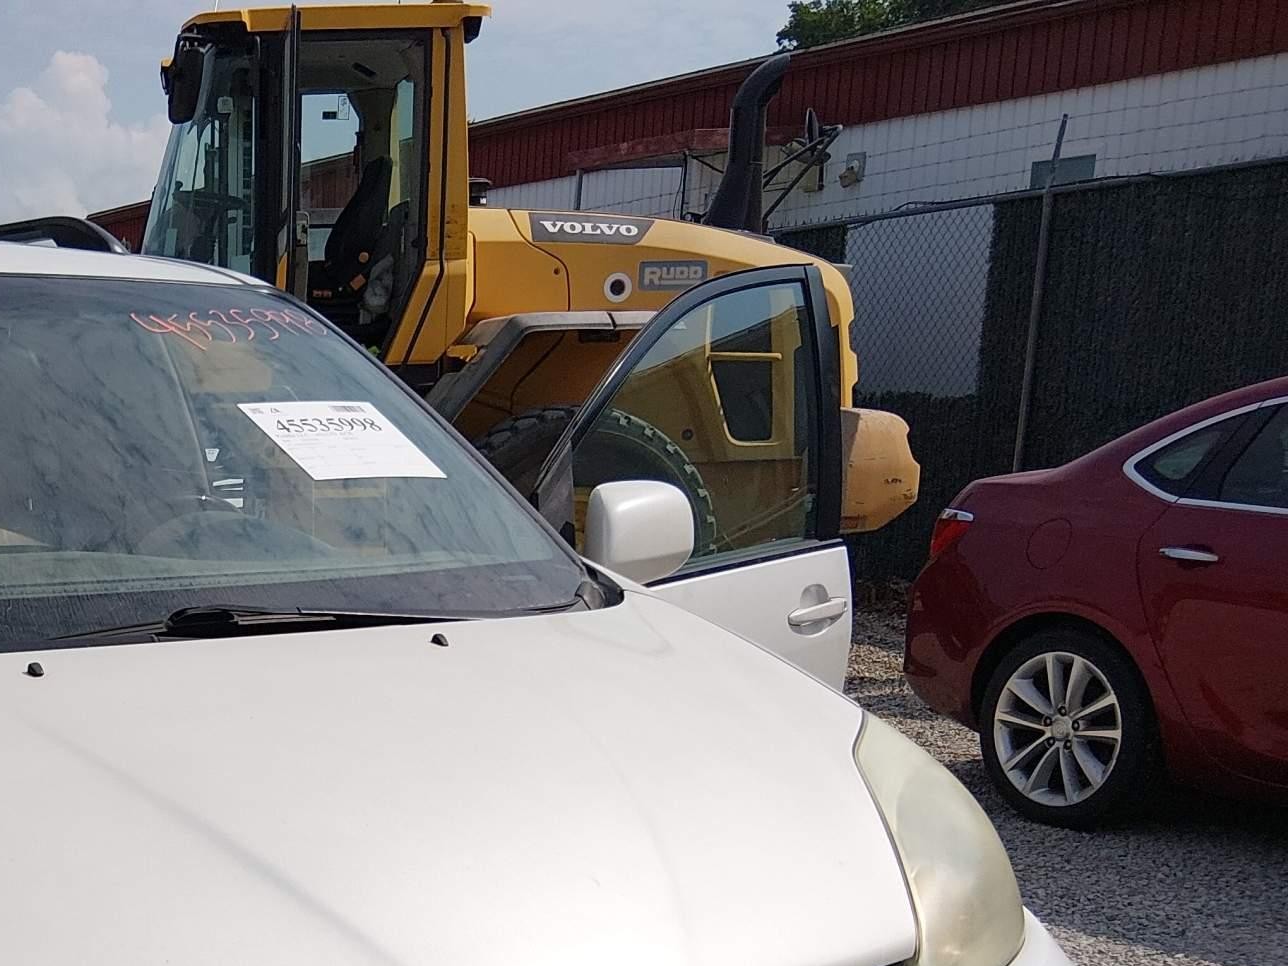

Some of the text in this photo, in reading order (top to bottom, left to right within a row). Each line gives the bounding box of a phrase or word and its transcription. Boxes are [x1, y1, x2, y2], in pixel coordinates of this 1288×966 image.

[539, 220, 640, 237] VOLVO
[643, 265, 703, 286] RUDD
[275, 416, 383, 434] 45535998
